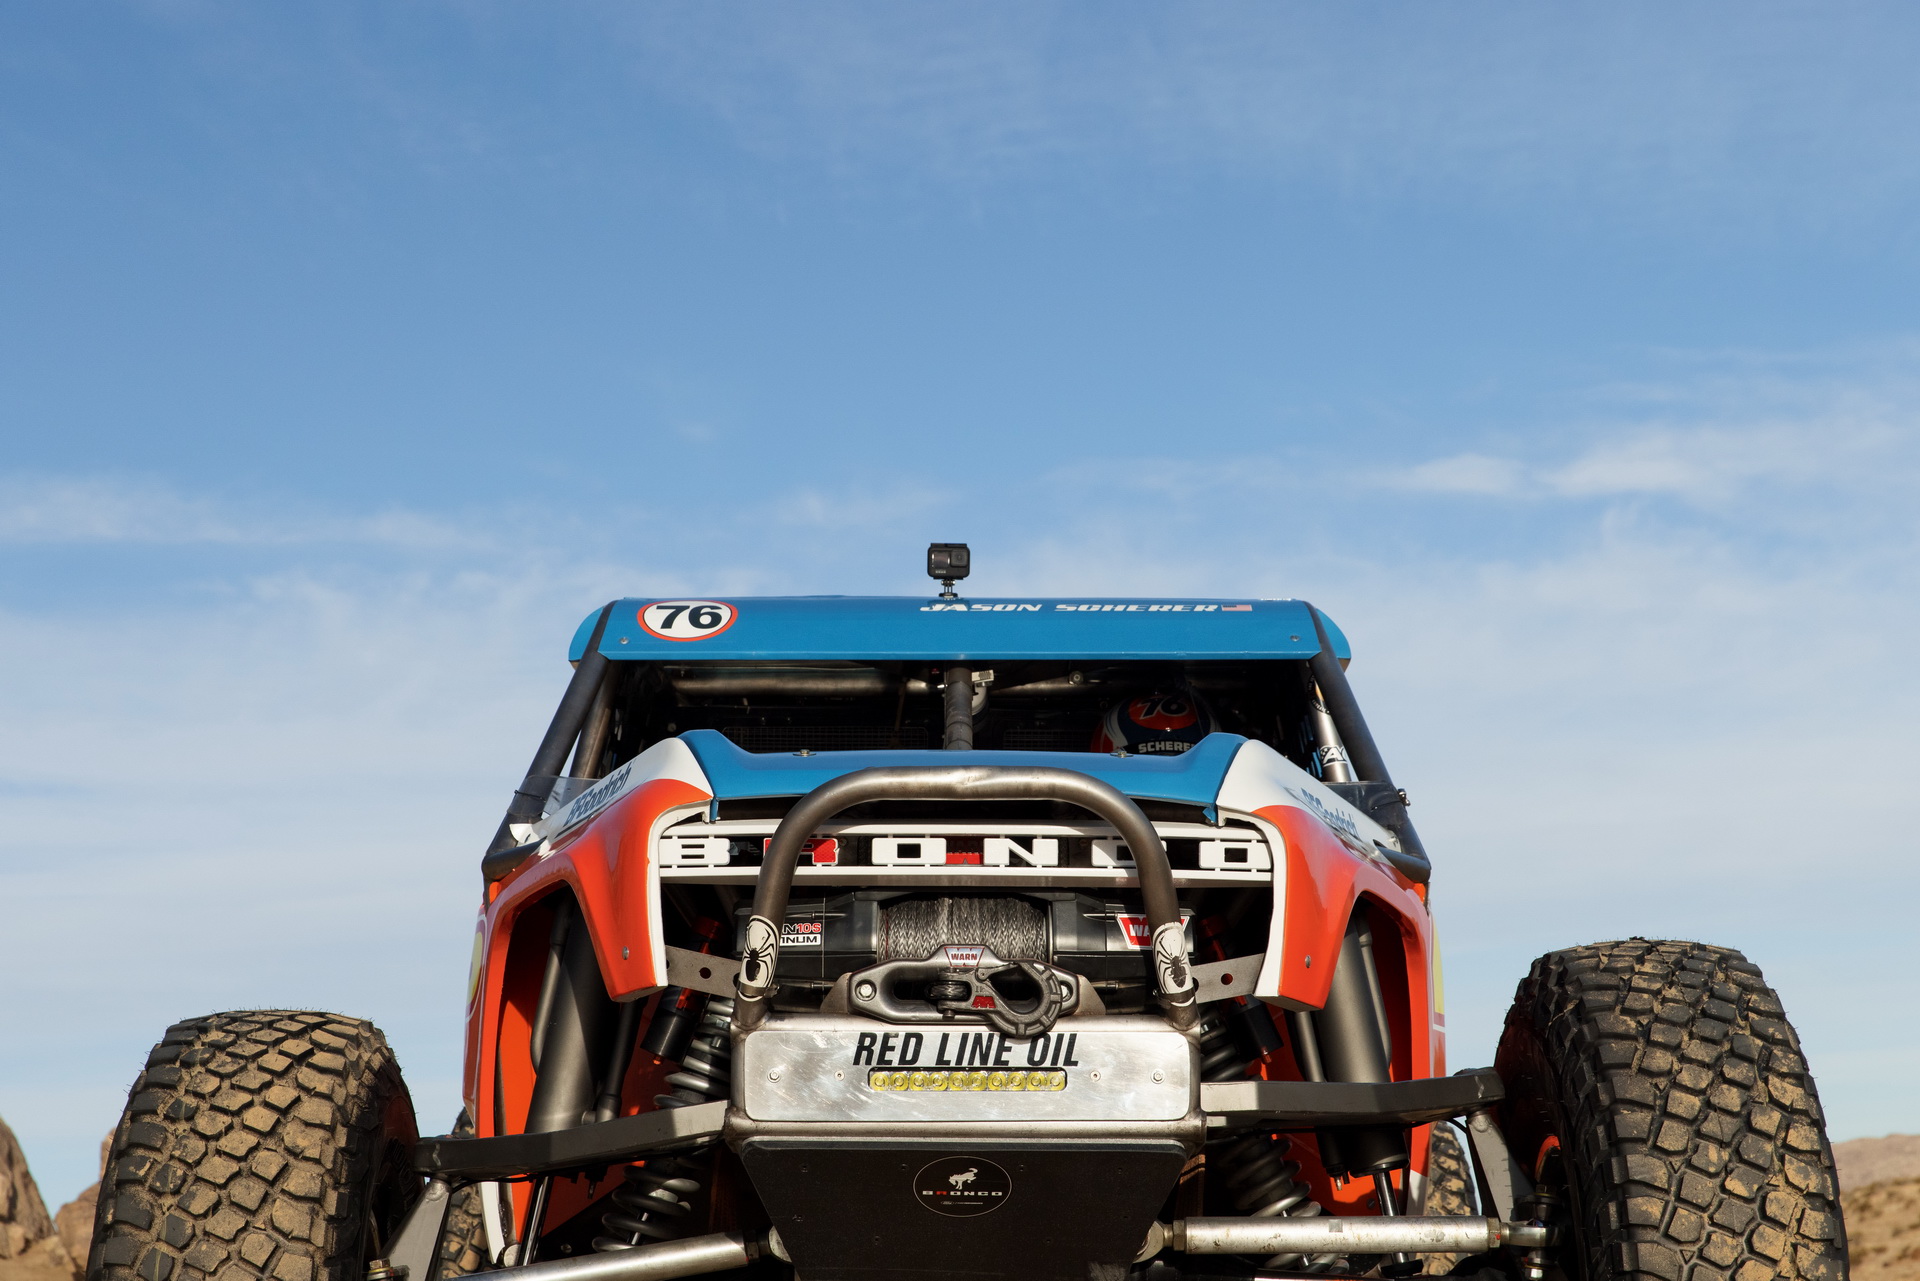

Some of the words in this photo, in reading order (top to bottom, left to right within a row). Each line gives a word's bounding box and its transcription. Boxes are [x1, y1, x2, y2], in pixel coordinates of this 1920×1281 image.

[919, 603, 1043, 612] JASON
[1054, 604, 1219, 612] SCHERER
[655, 605, 723, 630] 76
[1138, 741, 1195, 754] SCHERE
[951, 953, 978, 961] WARN
[852, 1032, 924, 1066] RED
[935, 1032, 1013, 1066] LINE
[1026, 1032, 1079, 1067] OIL
